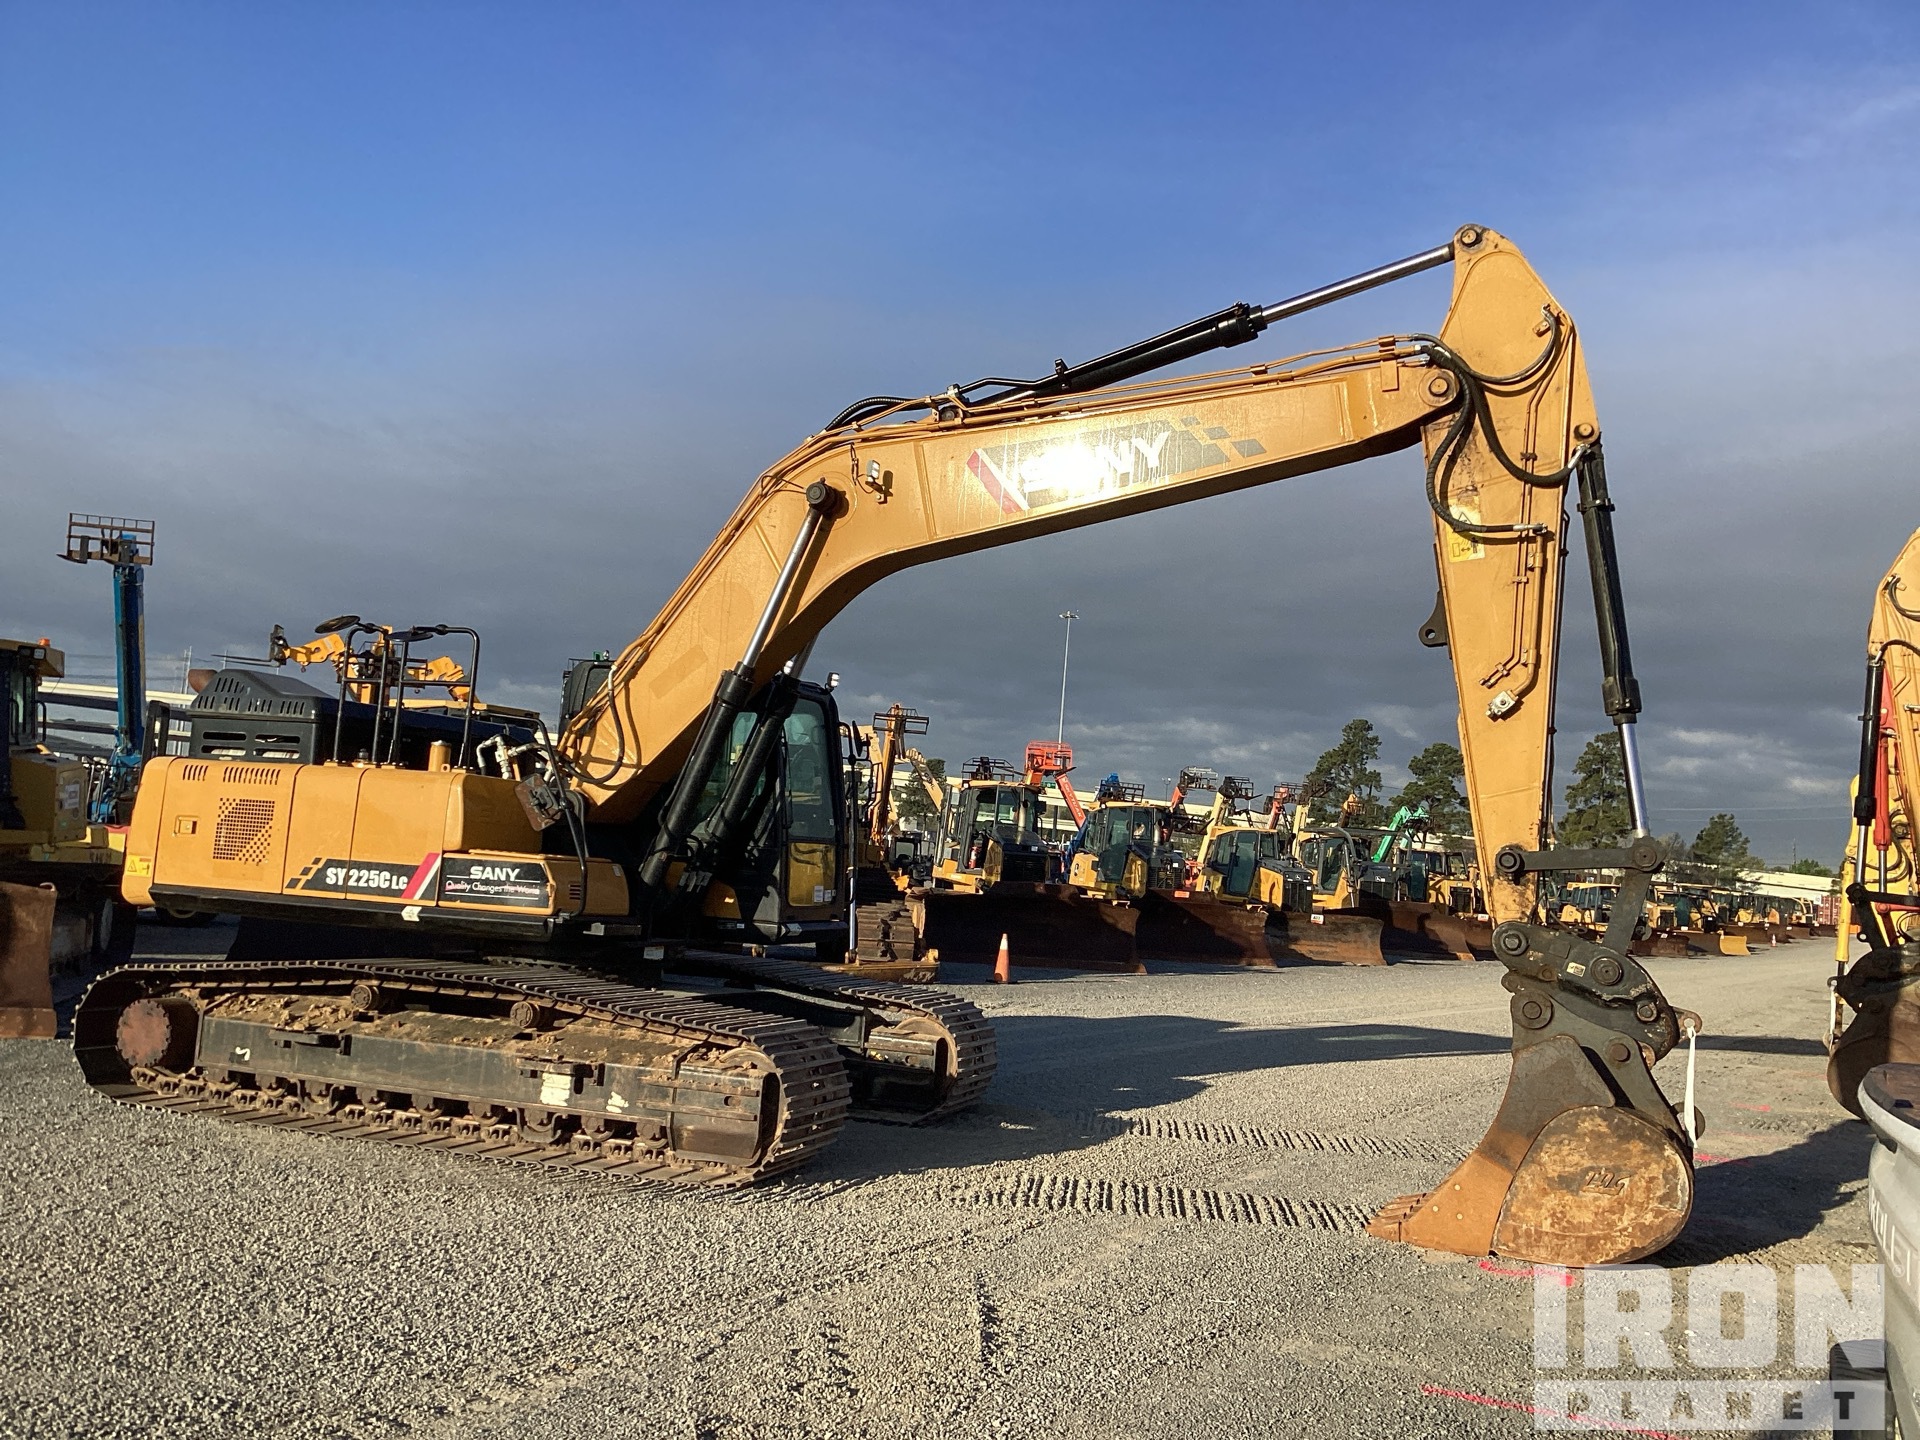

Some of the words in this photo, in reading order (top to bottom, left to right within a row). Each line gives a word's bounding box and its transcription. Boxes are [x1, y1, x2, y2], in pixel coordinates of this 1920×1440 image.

[1021, 431, 1171, 494] NY
[470, 865, 520, 881] SANY
[445, 880, 471, 892] Quality
[472, 881, 502, 894] Changes
